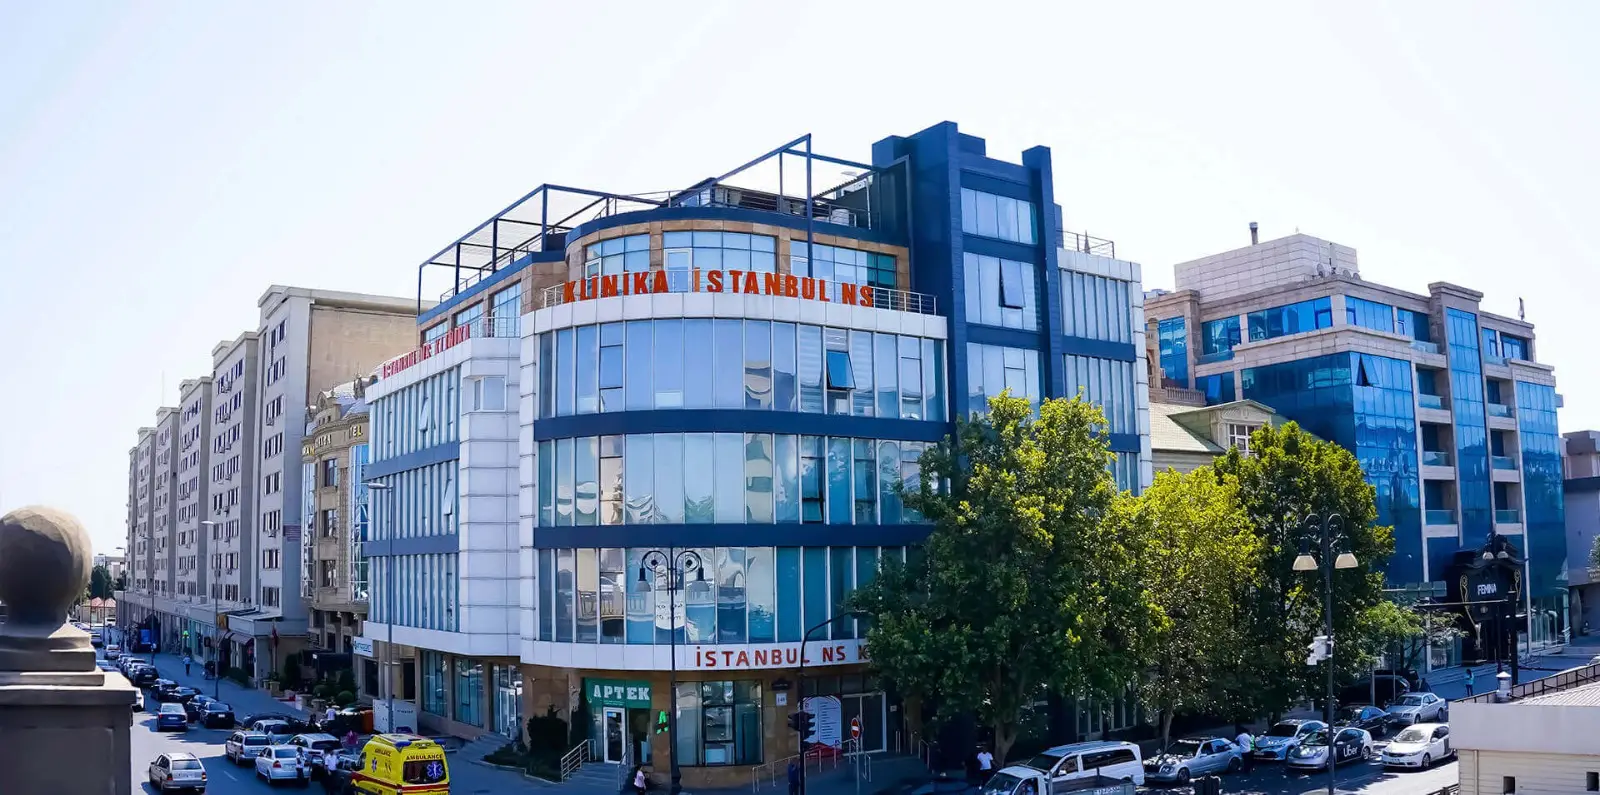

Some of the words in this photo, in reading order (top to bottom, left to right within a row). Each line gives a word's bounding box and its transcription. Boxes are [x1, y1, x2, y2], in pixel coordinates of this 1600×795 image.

[841, 282, 875, 308] NS
[822, 646, 846, 662] NS
[593, 684, 651, 700] APTEK
[1343, 744, 1359, 758] Uber
